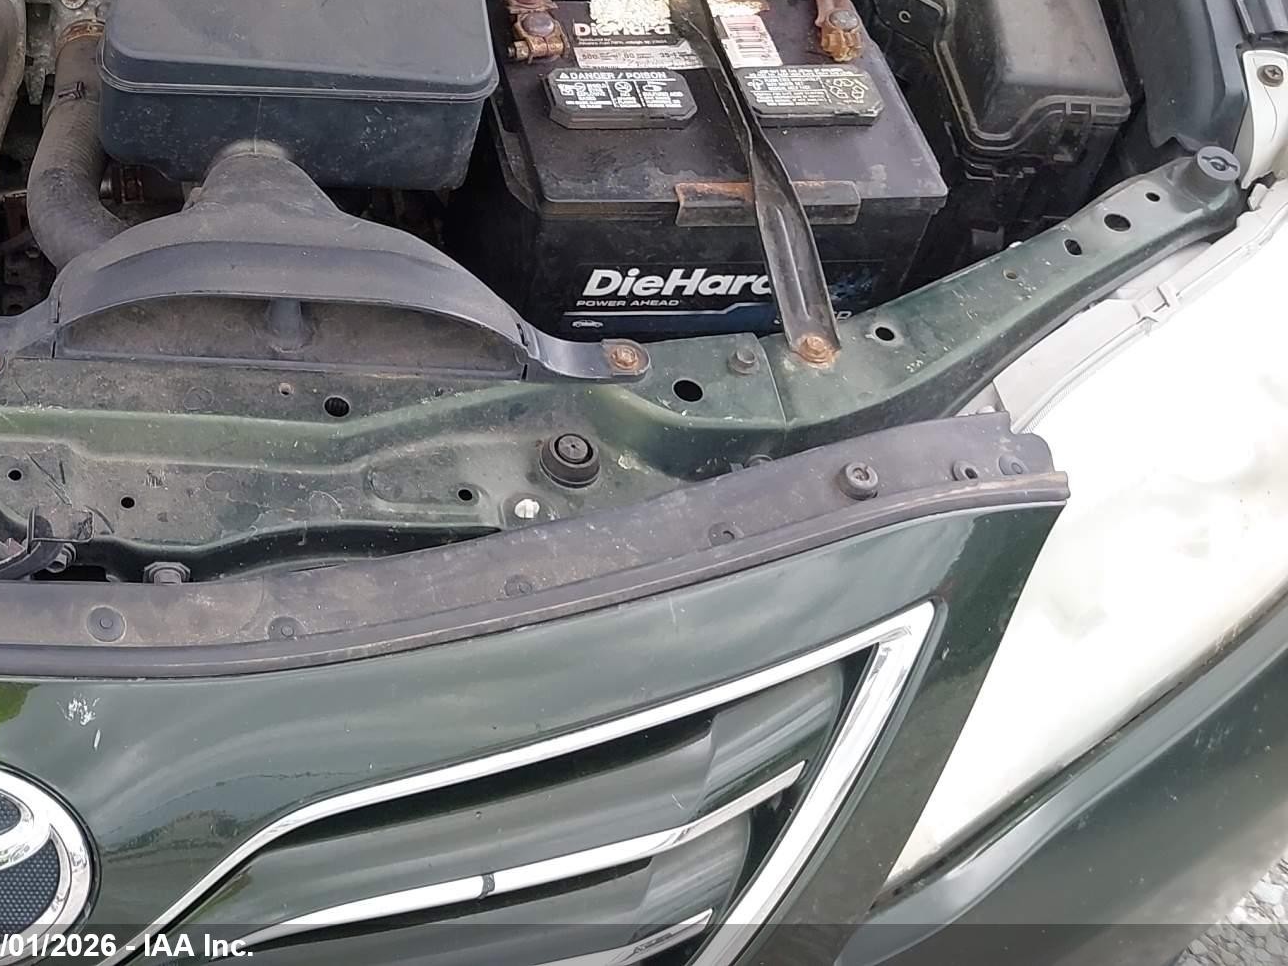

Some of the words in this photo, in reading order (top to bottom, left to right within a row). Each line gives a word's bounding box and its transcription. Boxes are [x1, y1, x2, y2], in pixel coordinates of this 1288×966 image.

[626, 71, 667, 79] POISON
[576, 299, 626, 307] POWER
[630, 299, 680, 307] AHEAD
